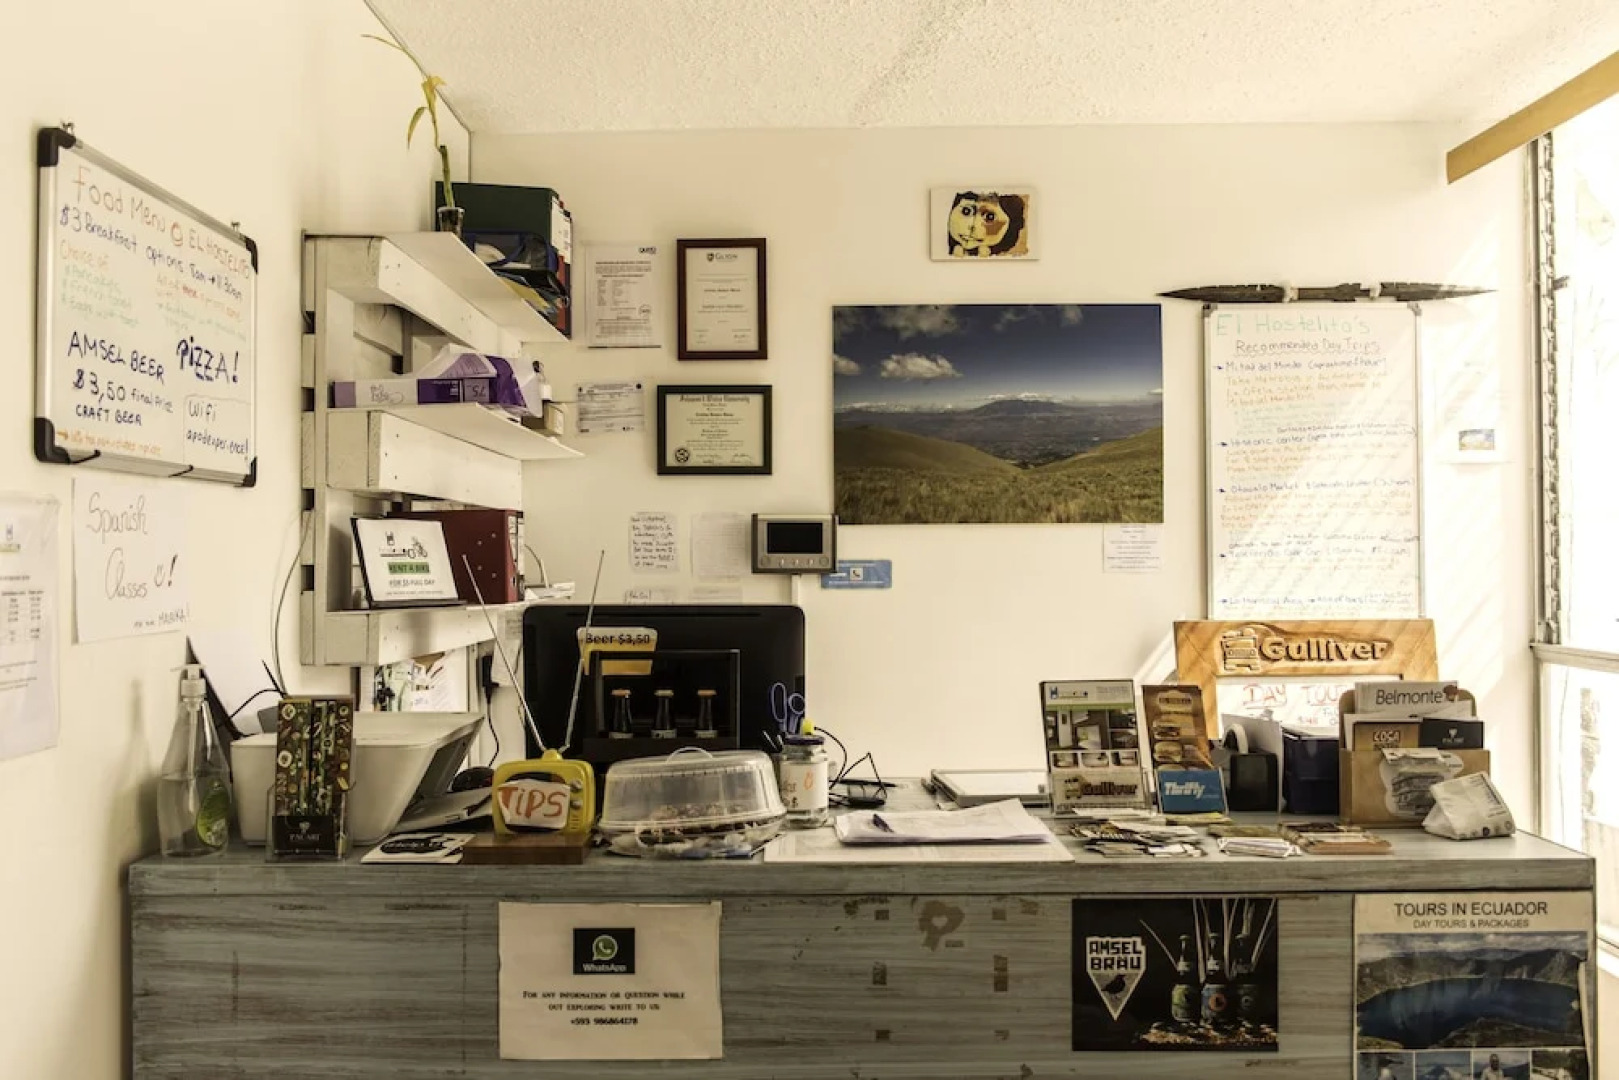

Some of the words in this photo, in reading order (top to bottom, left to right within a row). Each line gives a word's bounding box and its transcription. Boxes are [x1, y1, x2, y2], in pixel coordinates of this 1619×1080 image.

[72, 166, 123, 214] Food
[68, 331, 127, 367] AMSEL
[131, 350, 164, 386] BEER
[76, 404, 110, 422] CRAFT
[86, 491, 148, 544] Spanish
[105, 546, 149, 600] Classes
[586, 632, 612, 644] Beer
[1259, 637, 1389, 662] Gulliver
[1242, 682, 1289, 706] DAY
[1375, 688, 1444, 706] Belmonte
[1394, 901, 1448, 917] TOURS
[1451, 901, 1467, 916] IN
[1470, 900, 1549, 916] ECUADOR
[1412, 919, 1431, 929] DAY
[1434, 919, 1468, 929] TOURS
[1478, 919, 1530, 929] PACKAGES
[1088, 940, 1143, 954] AMSEL
[582, 962, 628, 973] WhatsApp
